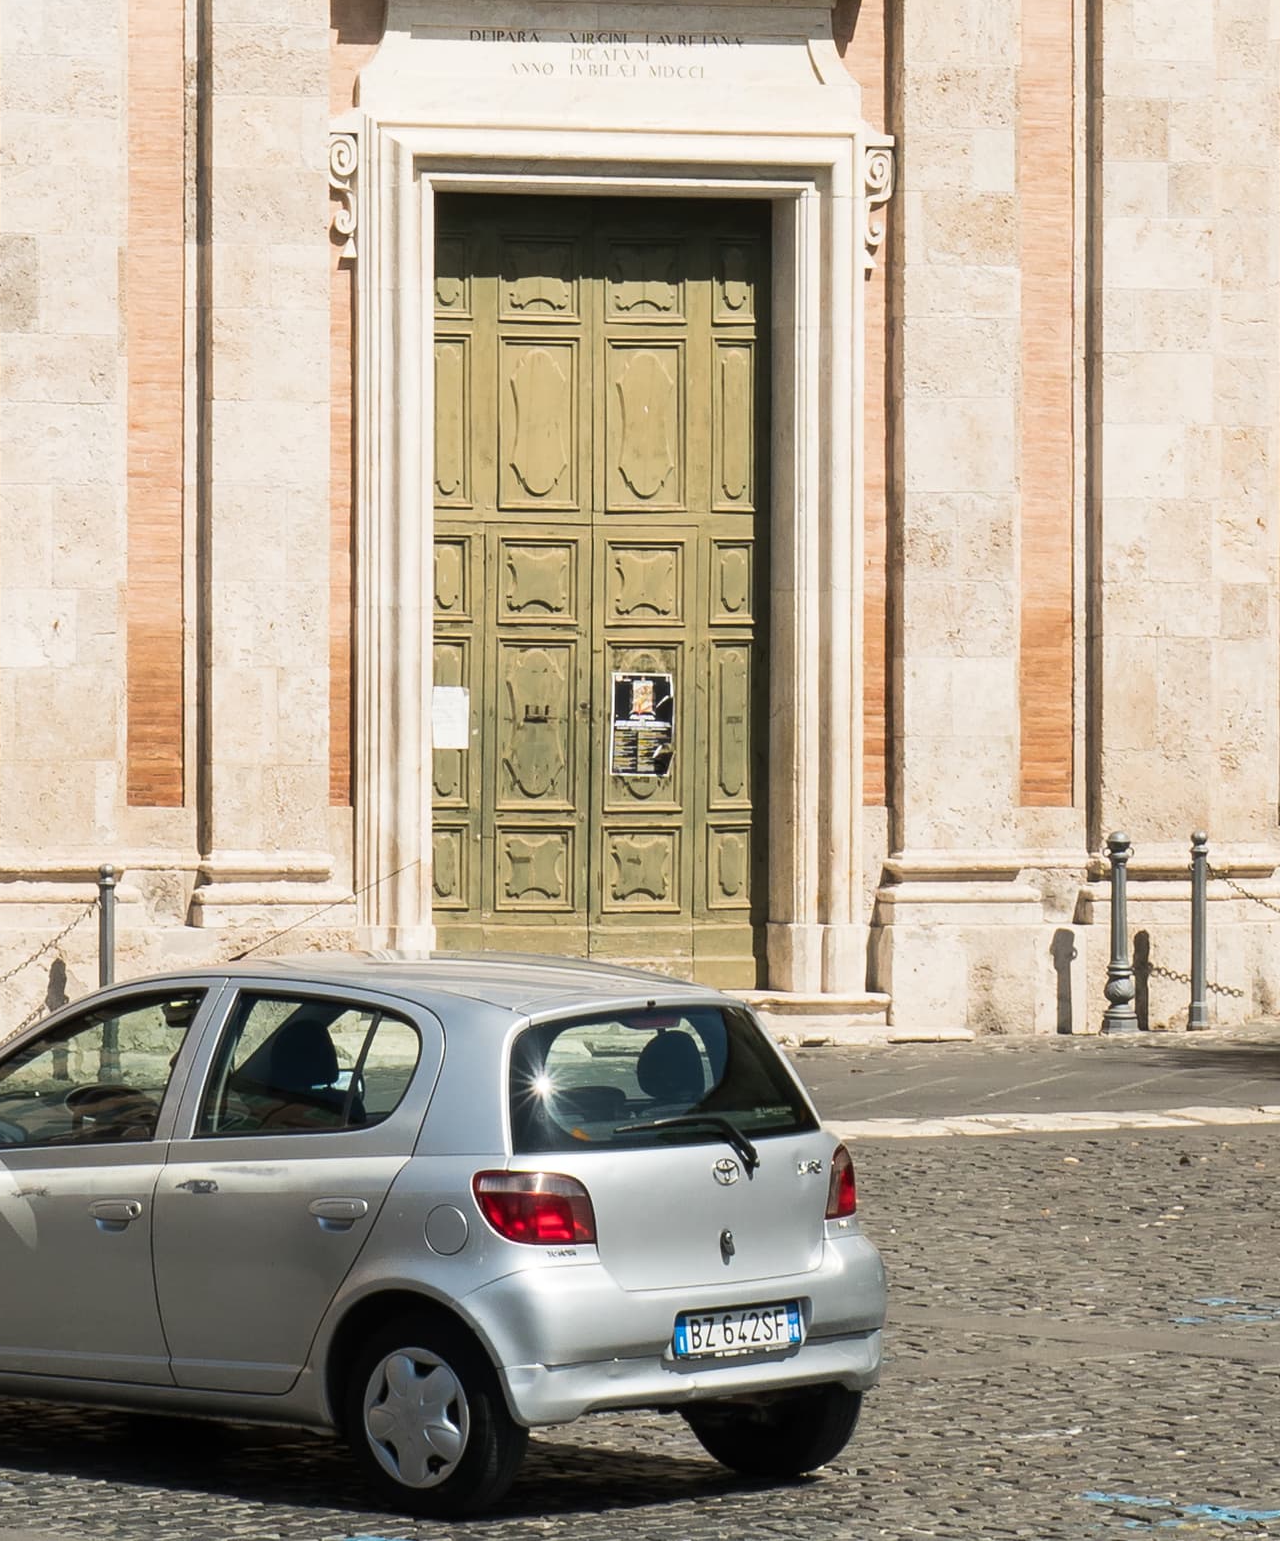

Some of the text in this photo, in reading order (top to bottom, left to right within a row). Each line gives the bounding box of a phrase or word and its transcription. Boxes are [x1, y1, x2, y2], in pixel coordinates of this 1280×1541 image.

[569, 32, 627, 44] VIRGINI
[571, 48, 649, 61] DICATVM
[511, 62, 554, 75] ANNO
[690, 1316, 716, 1350] BZ
[722, 1308, 785, 1345] 642SF
